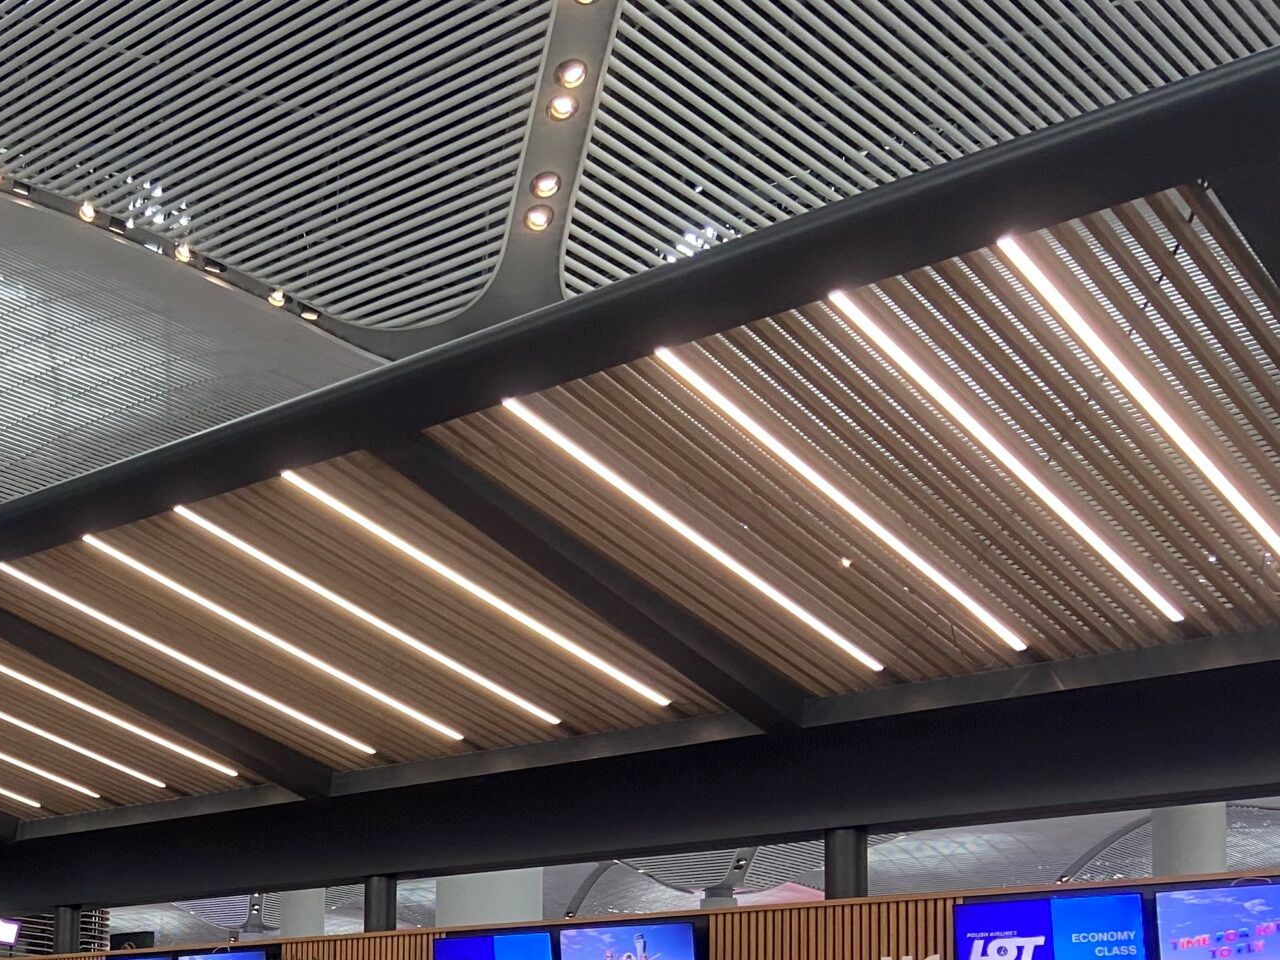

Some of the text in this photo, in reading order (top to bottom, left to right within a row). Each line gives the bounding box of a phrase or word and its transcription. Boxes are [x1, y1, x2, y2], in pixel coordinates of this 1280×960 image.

[1071, 930, 1136, 944] ECONOMY
[1216, 927, 1250, 943] FOR
[1094, 945, 1138, 958] CLASS
[1209, 945, 1233, 960] TO
